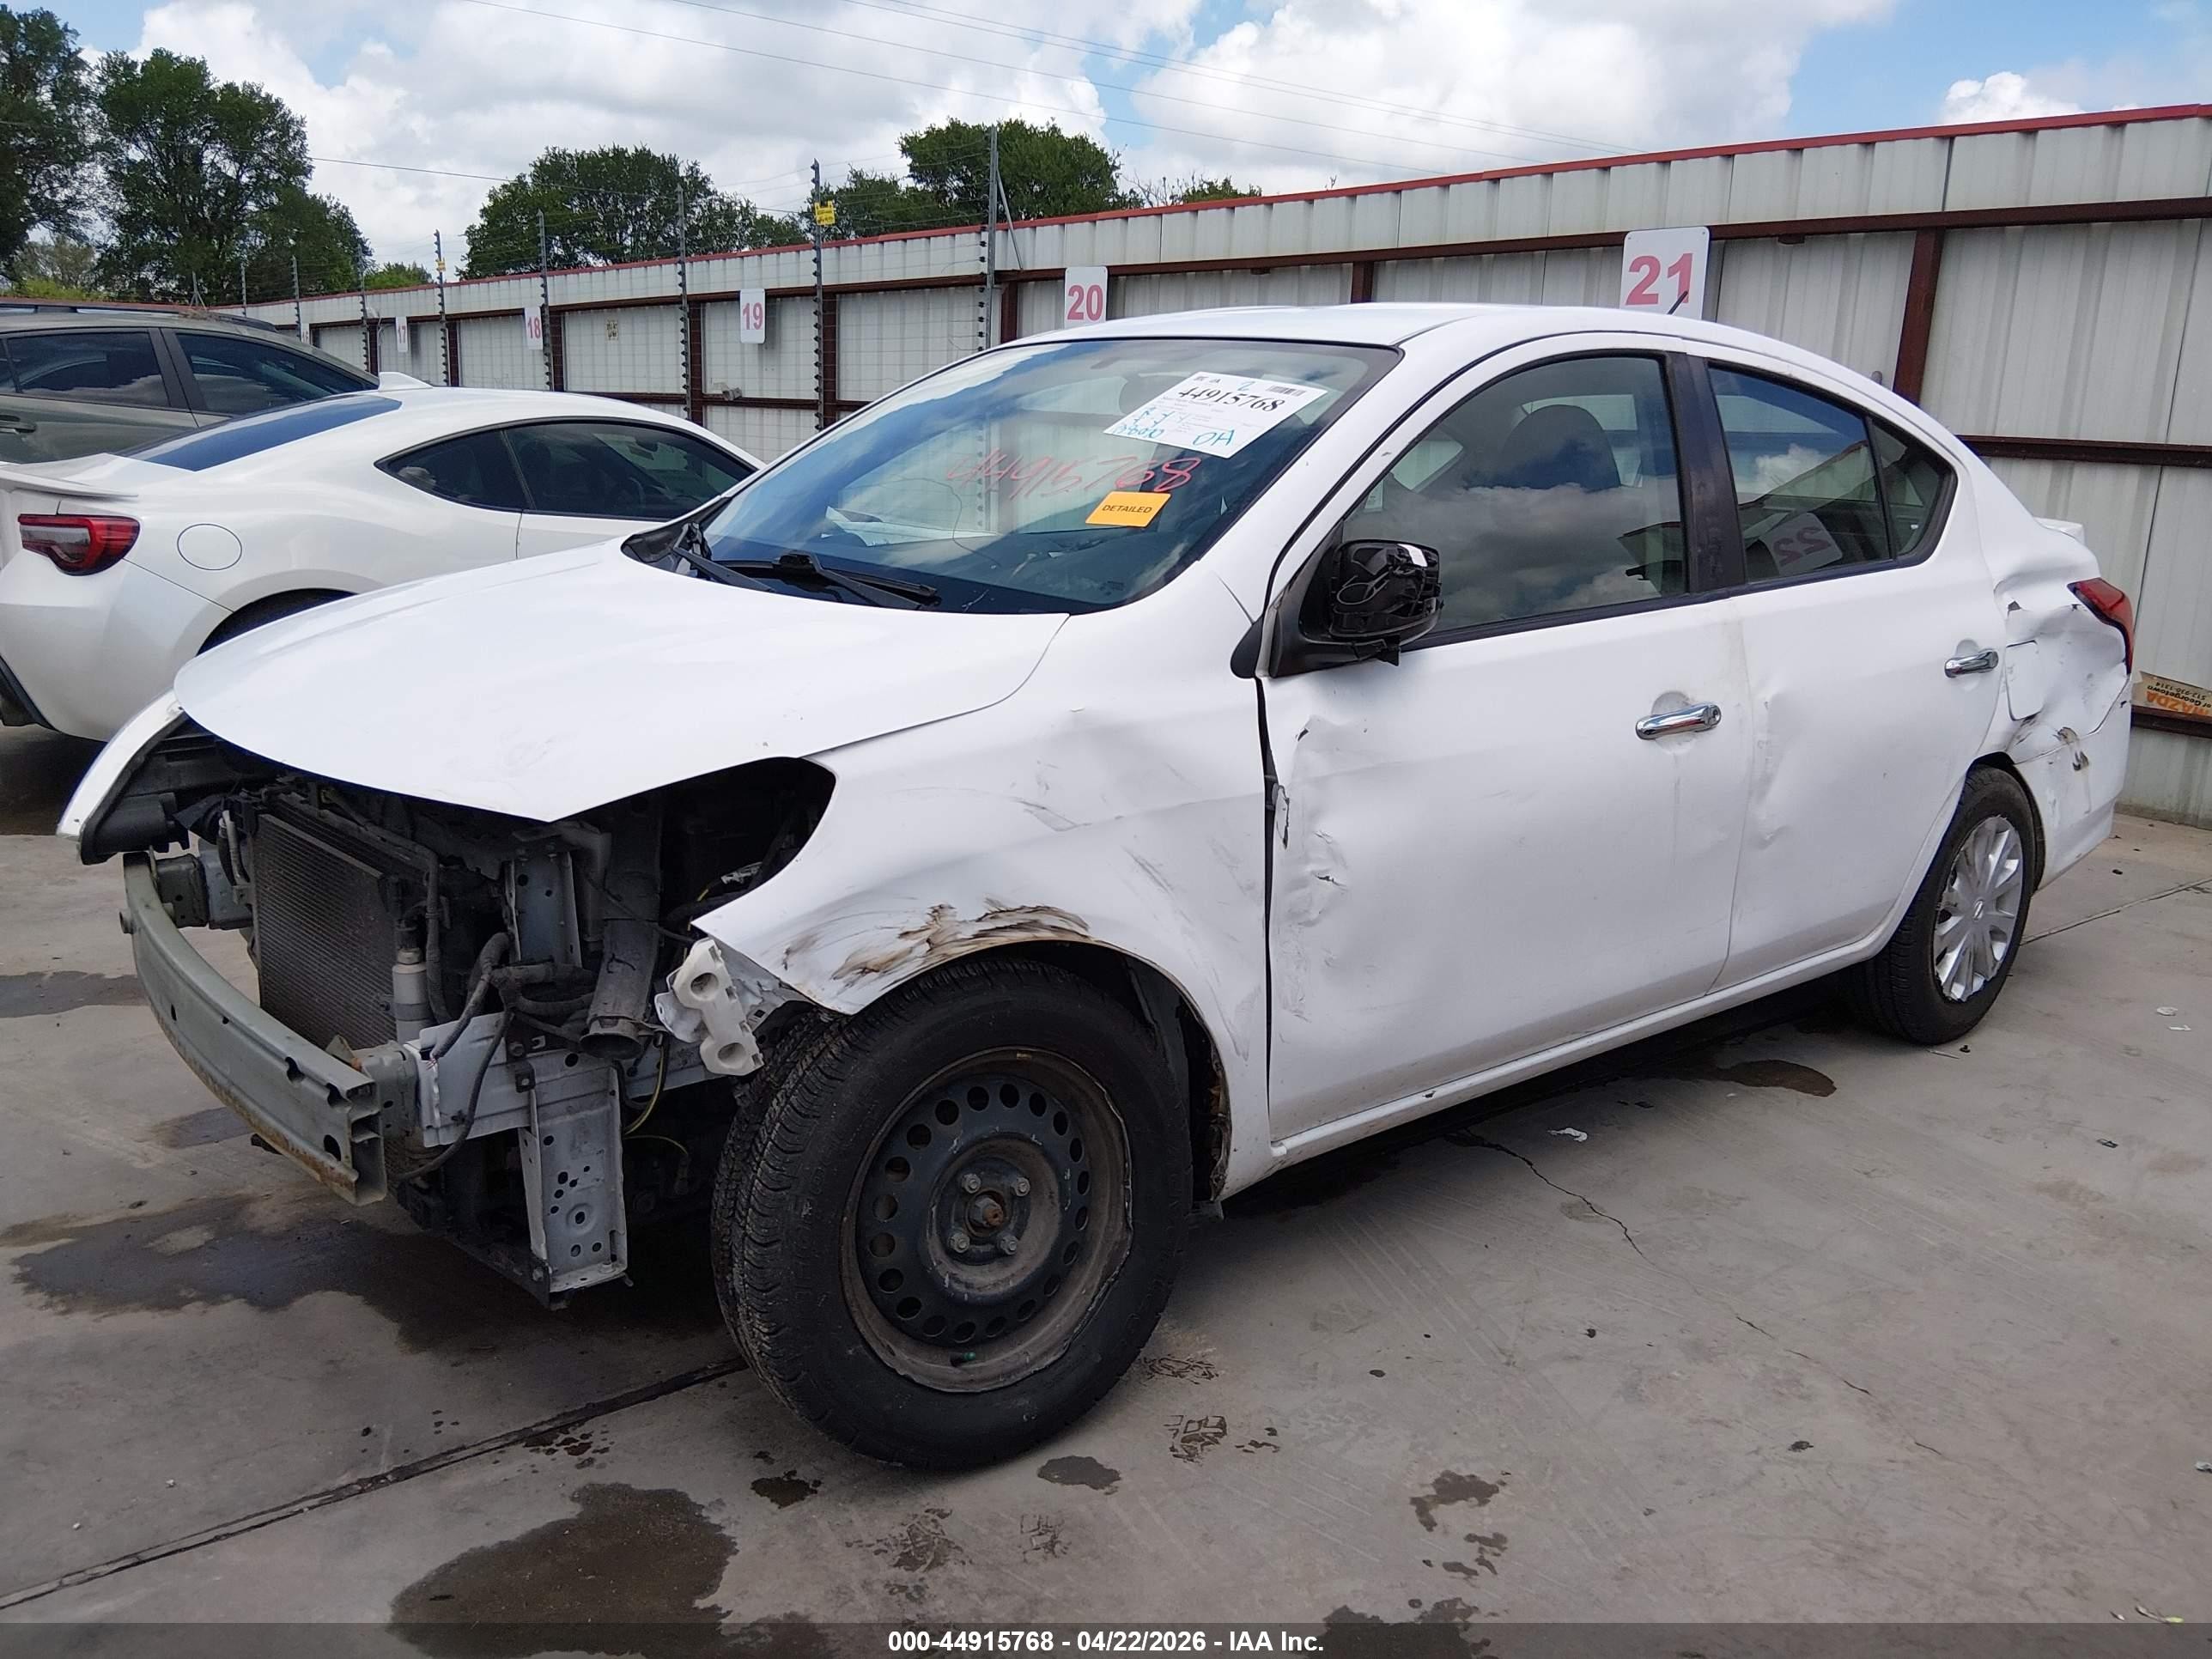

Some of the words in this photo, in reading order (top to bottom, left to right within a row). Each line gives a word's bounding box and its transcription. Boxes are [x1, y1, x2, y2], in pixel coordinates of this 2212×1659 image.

[1626, 252, 1692, 305] 21
[1067, 284, 1103, 321] 20
[527, 316, 541, 339] 18
[742, 302, 763, 331] 19
[398, 325, 406, 344] 17
[1178, 386, 1285, 412] 44915768
[1102, 504, 1152, 514] DETAILED
[2147, 685, 2202, 707] Georgetown
